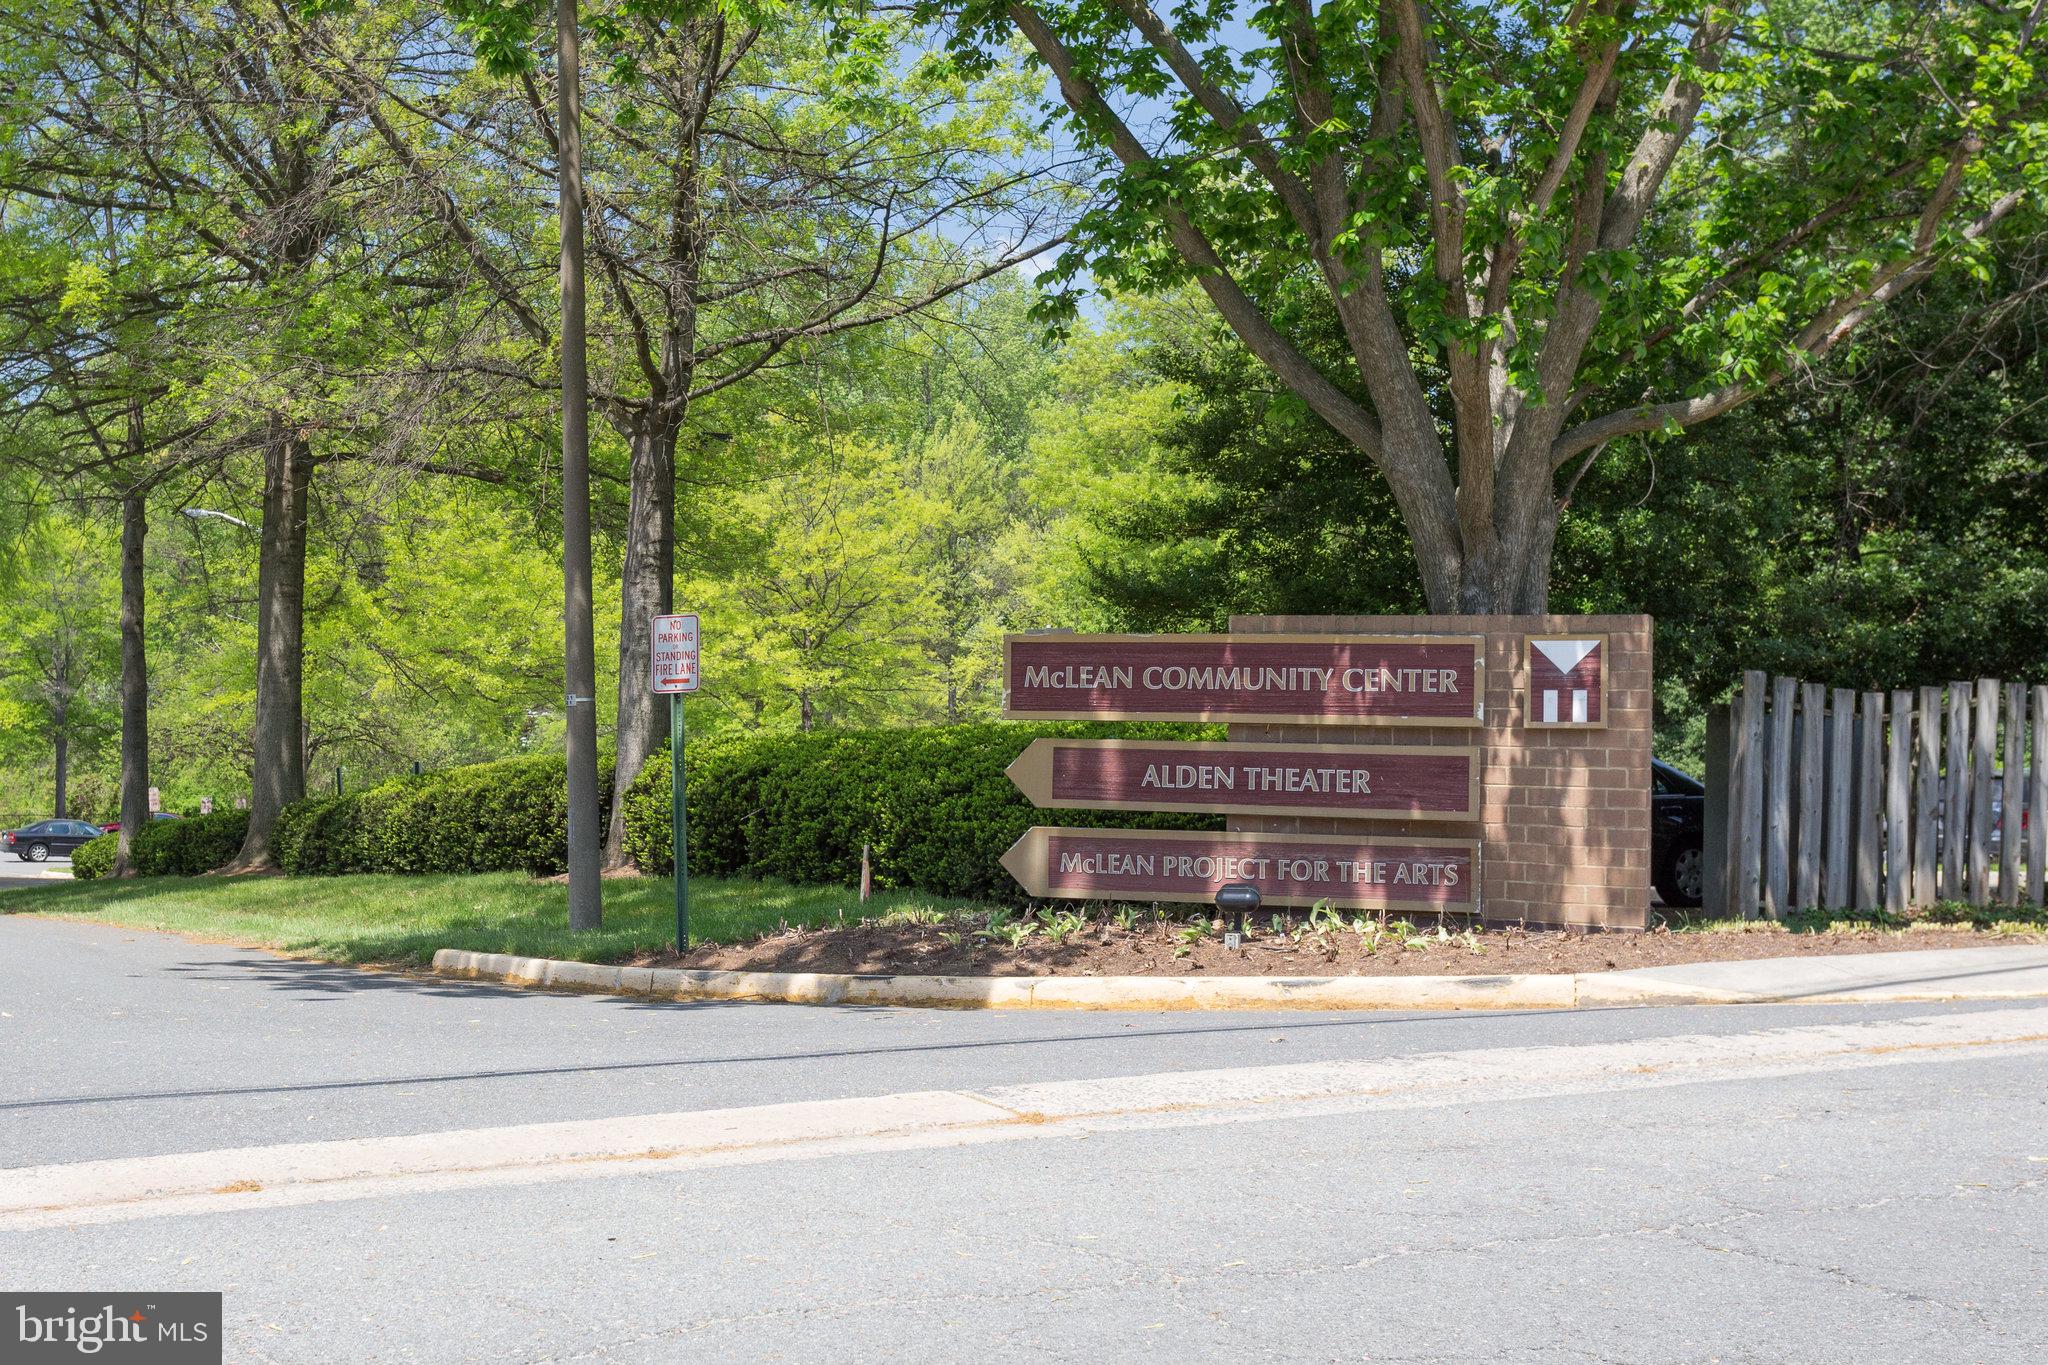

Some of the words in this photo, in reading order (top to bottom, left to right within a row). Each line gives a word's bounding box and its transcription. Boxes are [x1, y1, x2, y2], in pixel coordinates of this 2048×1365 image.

[670, 620, 682, 631] NO
[658, 632, 693, 643] PARKING
[656, 651, 696, 662] STANDING
[656, 663, 673, 676] FIRE
[675, 662, 696, 675] LANE
[1024, 665, 1133, 689] McLEAN
[1142, 666, 1334, 691] COMMUNITY
[1342, 668, 1458, 693] CENTER
[1141, 764, 1235, 790] ALDEN
[1243, 767, 1371, 794] THEATER
[1059, 852, 1154, 876] McLEAN
[1163, 856, 1270, 883] PROJECT
[1277, 859, 1330, 882] FOR
[1336, 861, 1386, 884] THE
[1393, 862, 1459, 886] ARTS
